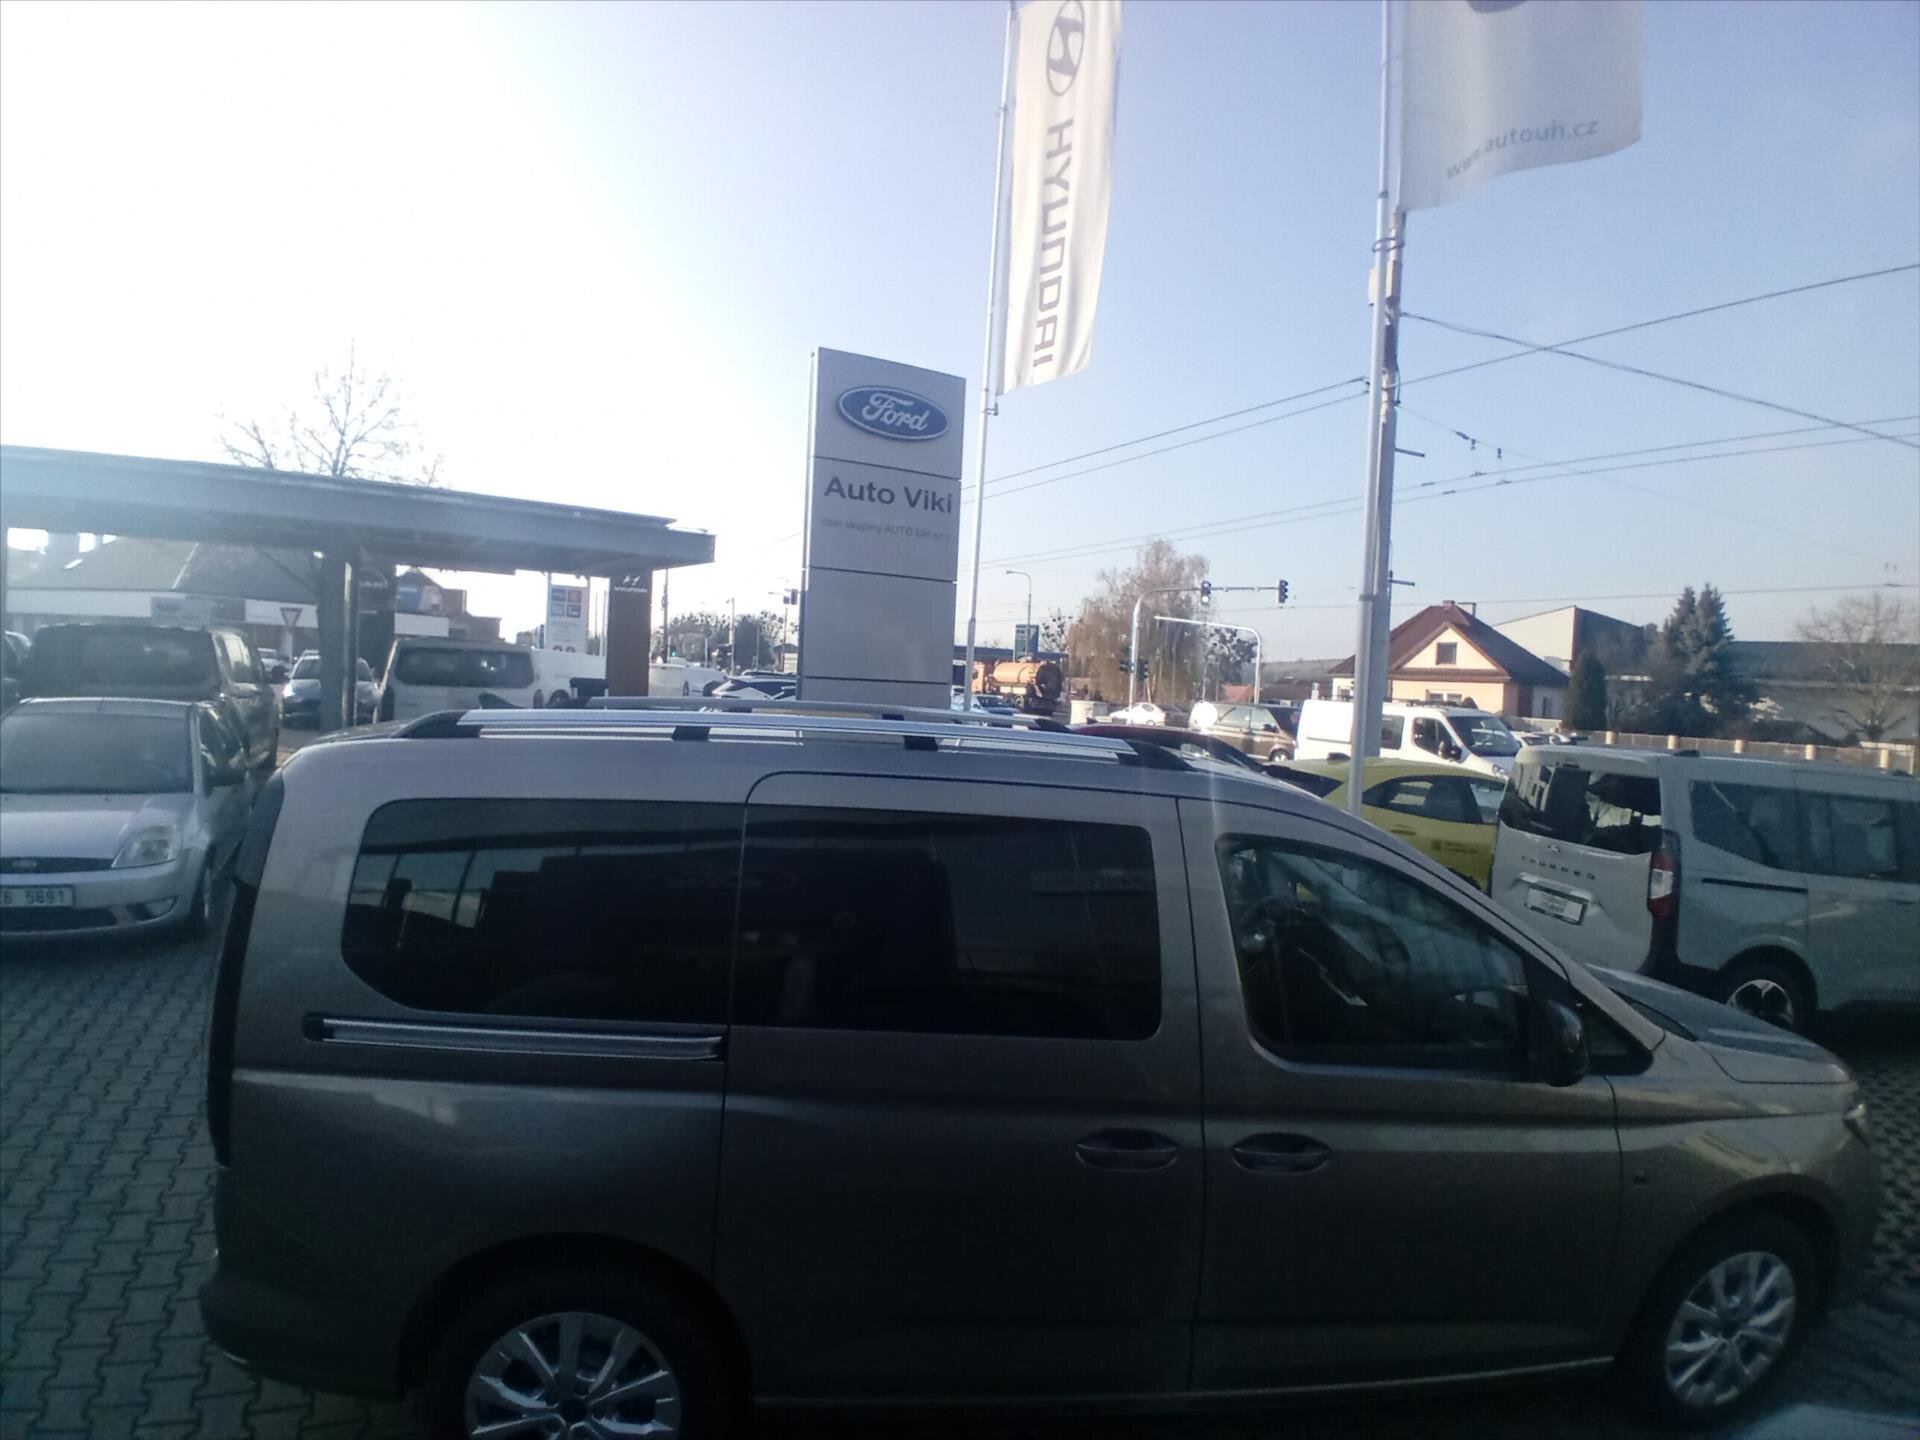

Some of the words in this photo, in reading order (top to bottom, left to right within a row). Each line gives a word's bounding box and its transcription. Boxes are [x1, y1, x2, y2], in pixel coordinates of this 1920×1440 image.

[1446, 120, 1599, 179] www.autouh.cz
[1032, 117, 1074, 368] HYUNDAI
[861, 392, 931, 431] Ford
[823, 475, 896, 505] Auto
[903, 486, 953, 514] Viki
